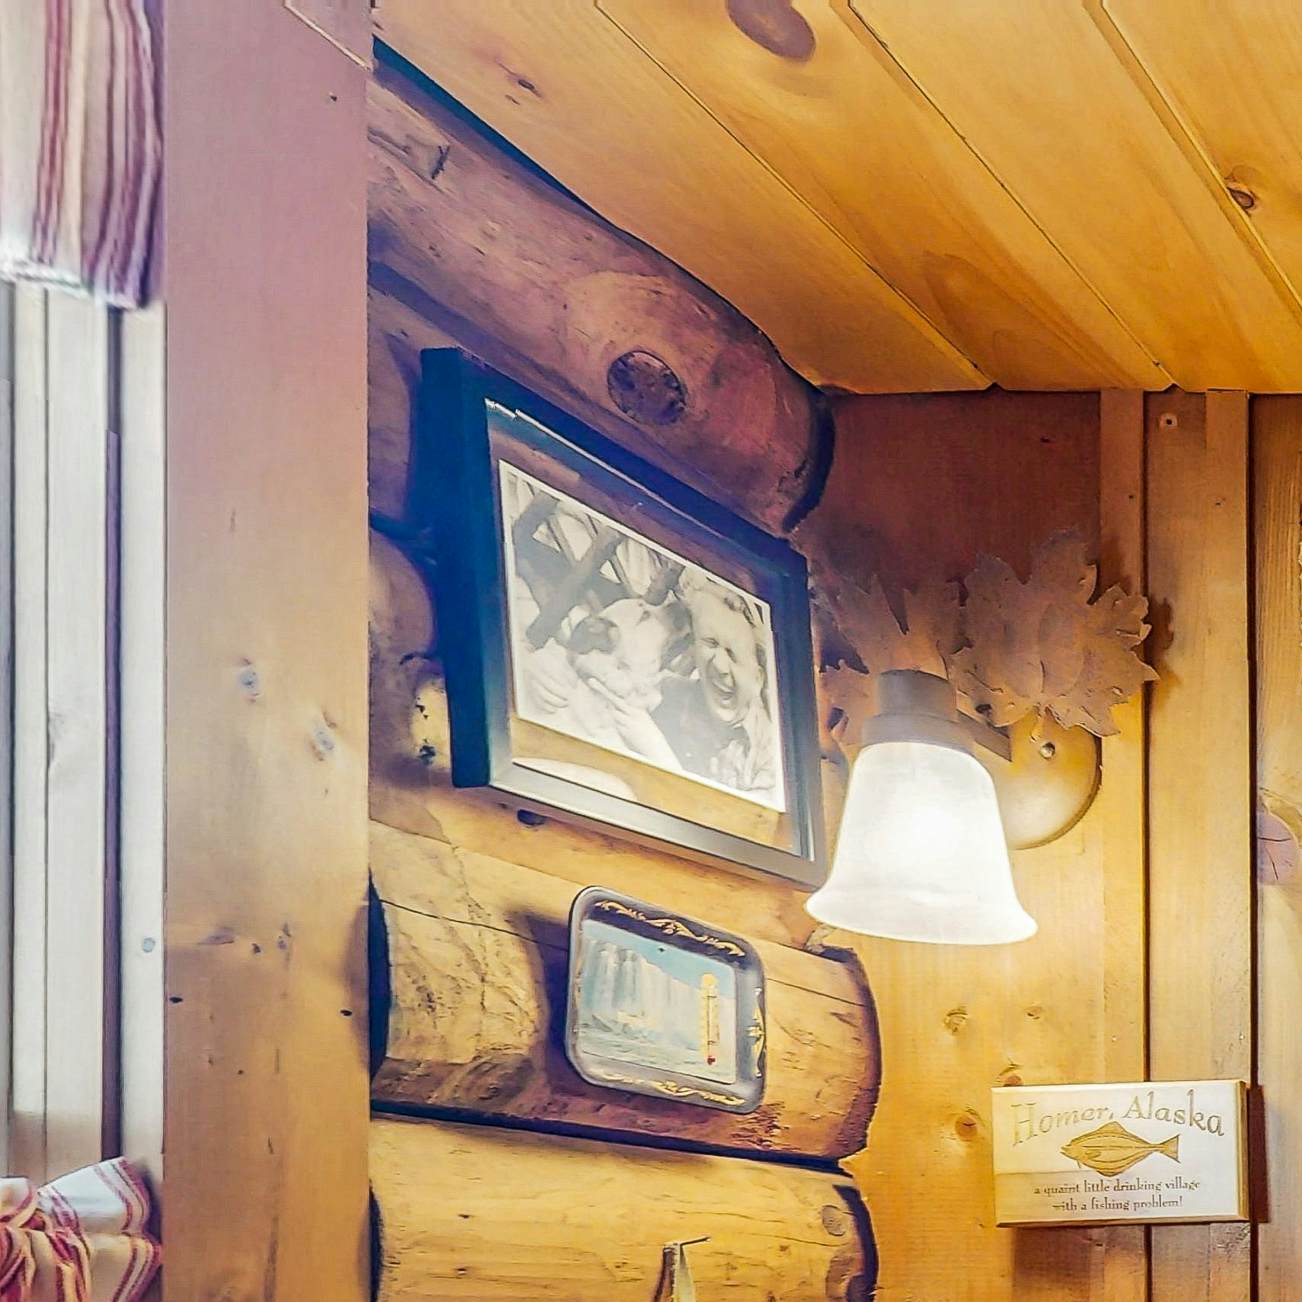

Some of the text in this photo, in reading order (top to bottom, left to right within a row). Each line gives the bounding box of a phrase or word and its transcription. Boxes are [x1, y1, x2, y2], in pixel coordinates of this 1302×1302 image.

[1122, 1088, 1225, 1137] Alaska
[1043, 1183, 1080, 1198] quaint
[1084, 1179, 1110, 1192] little
[1113, 1177, 1163, 1192] drinking
[1165, 1176, 1201, 1191] village
[1080, 1203, 1087, 1211] a
[1091, 1196, 1130, 1212] fishing
